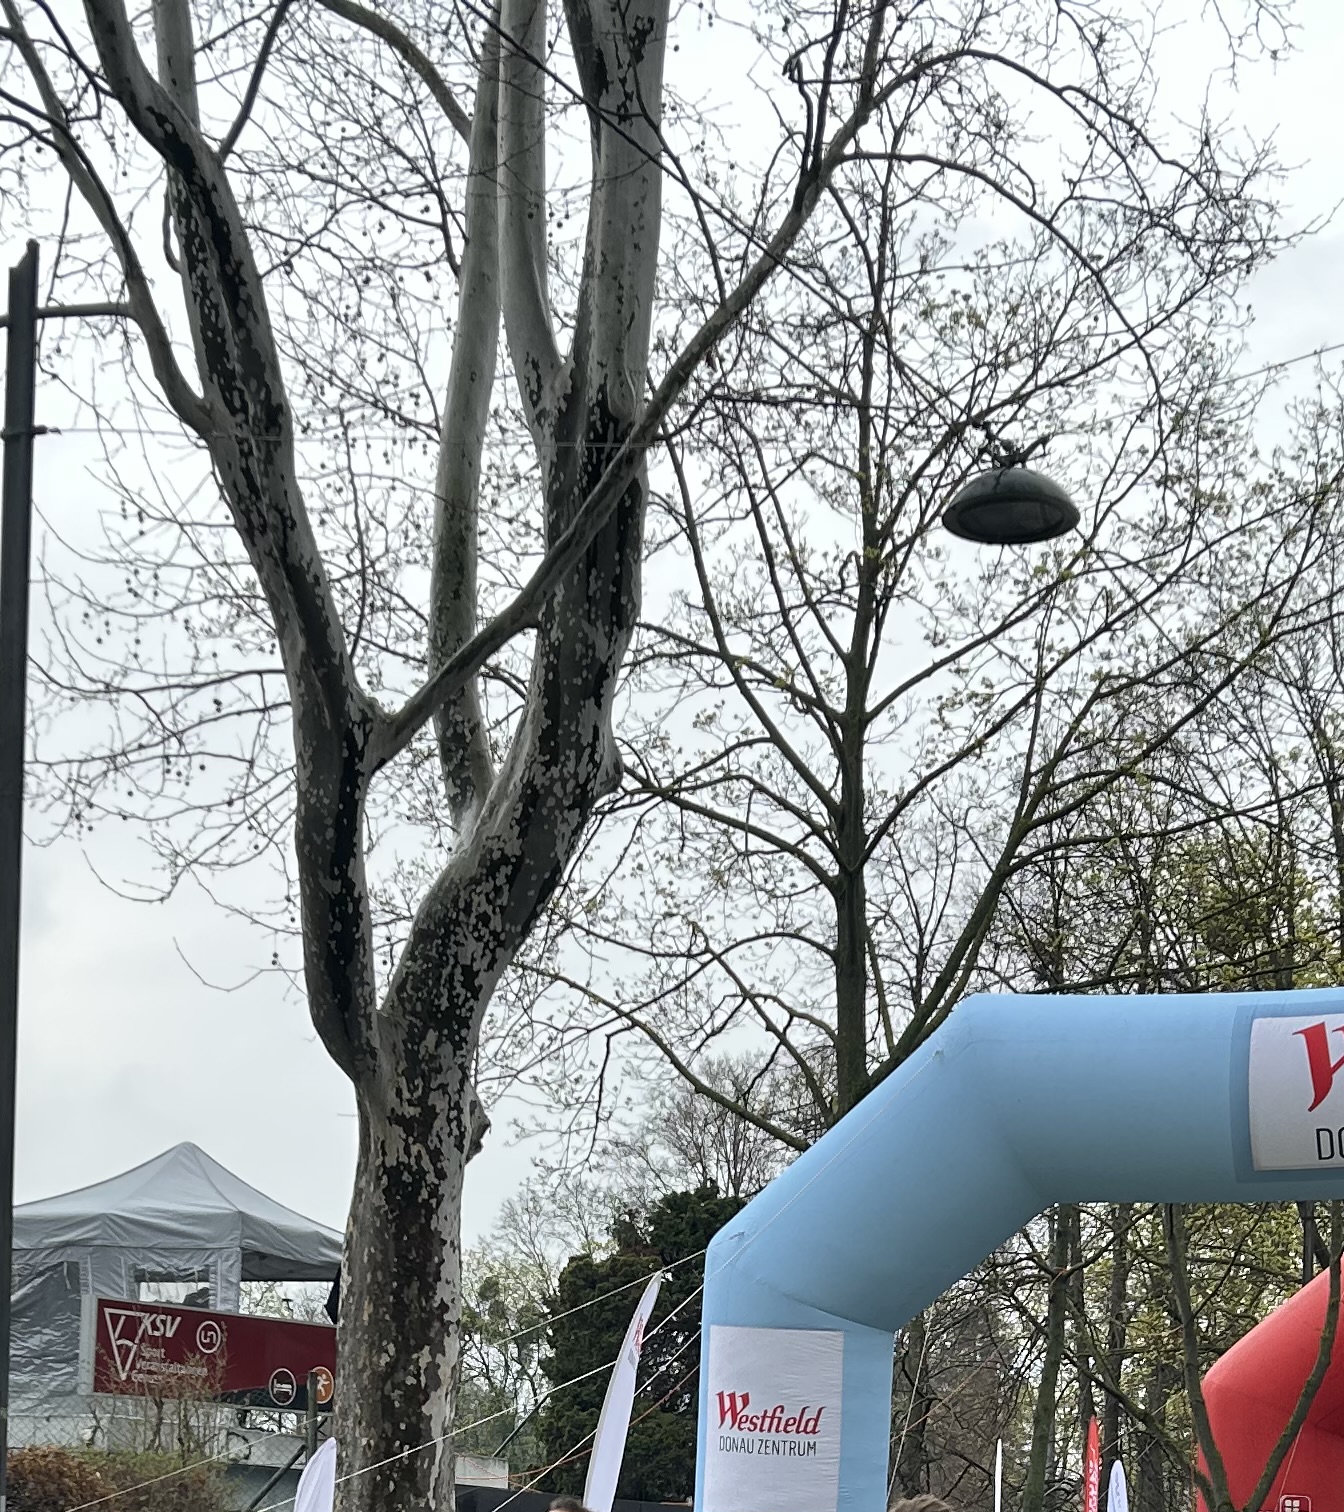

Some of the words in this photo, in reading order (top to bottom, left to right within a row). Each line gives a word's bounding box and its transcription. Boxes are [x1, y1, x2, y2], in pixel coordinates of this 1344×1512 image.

[143, 1313, 182, 1338] KSV
[715, 1390, 828, 1435] Westfield
[719, 1435, 754, 1455] DONAU
[757, 1438, 817, 1457] ZENTRUM
